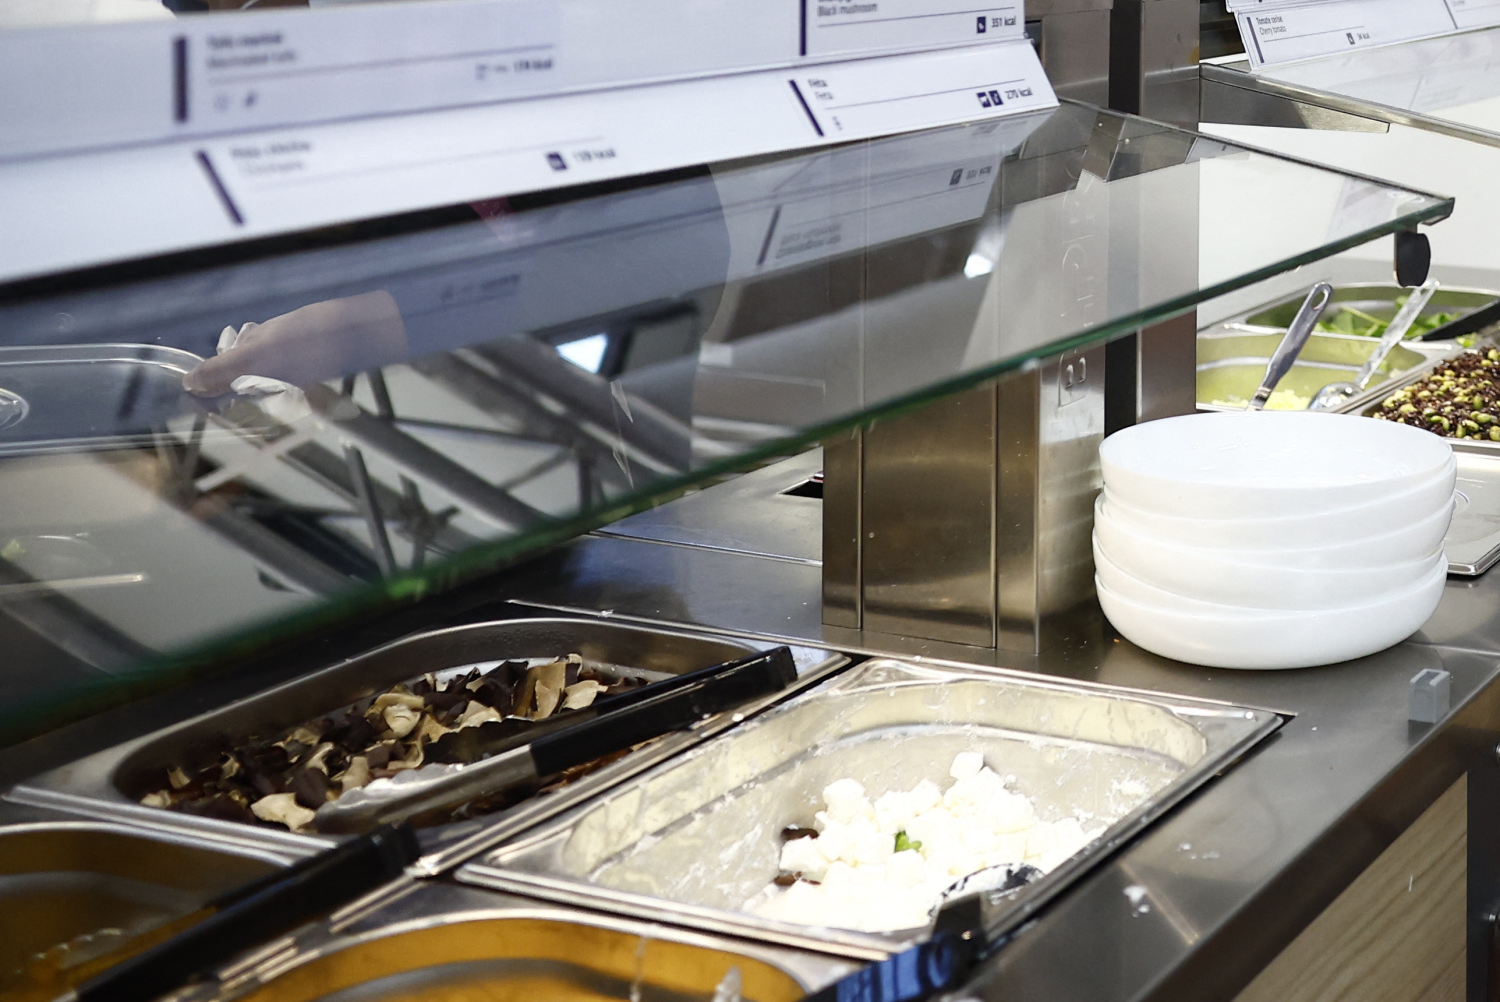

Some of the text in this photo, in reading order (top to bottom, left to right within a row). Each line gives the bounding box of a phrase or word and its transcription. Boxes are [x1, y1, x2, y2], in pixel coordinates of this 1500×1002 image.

[1004, 15, 1016, 26] kcal
[1256, 17, 1271, 25] Tomate
[1260, 27, 1273, 36] Cherry
[1019, 86, 1033, 97] kcal
